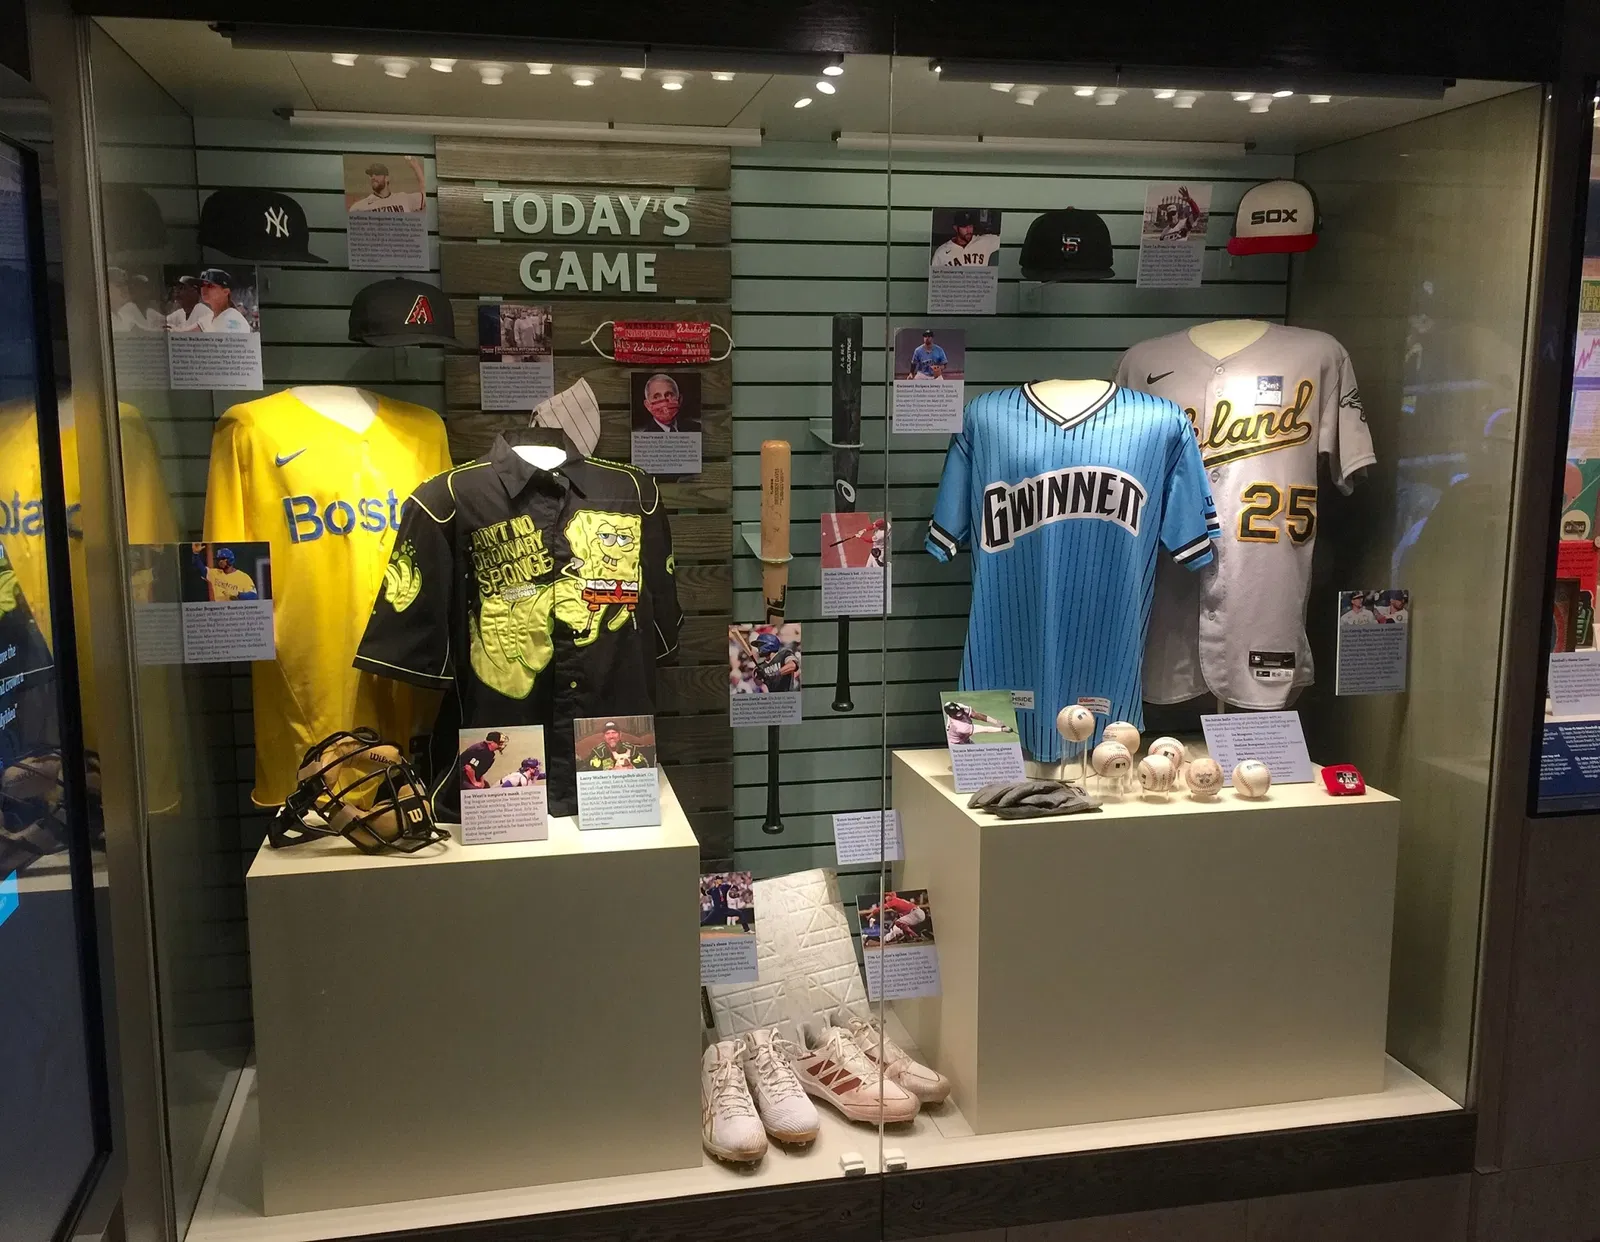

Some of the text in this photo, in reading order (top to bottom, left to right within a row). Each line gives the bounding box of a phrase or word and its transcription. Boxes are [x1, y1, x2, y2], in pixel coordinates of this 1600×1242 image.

[264, 206, 289, 237] NY
[483, 193, 690, 236] TODAY'S
[1251, 209, 1298, 225] SOX
[519, 251, 657, 292] GAME
[634, 343, 678, 354] Washington
[1200, 379, 1313, 449] land
[282, 488, 406, 545] Bost
[983, 469, 1146, 550] GWINNETT
[1237, 481, 1318, 546] 25
[471, 514, 535, 550] AIN'T NO
[472, 529, 544, 571] ORDINARY
[478, 548, 555, 594] SPONGE
[407, 808, 423, 823] W
